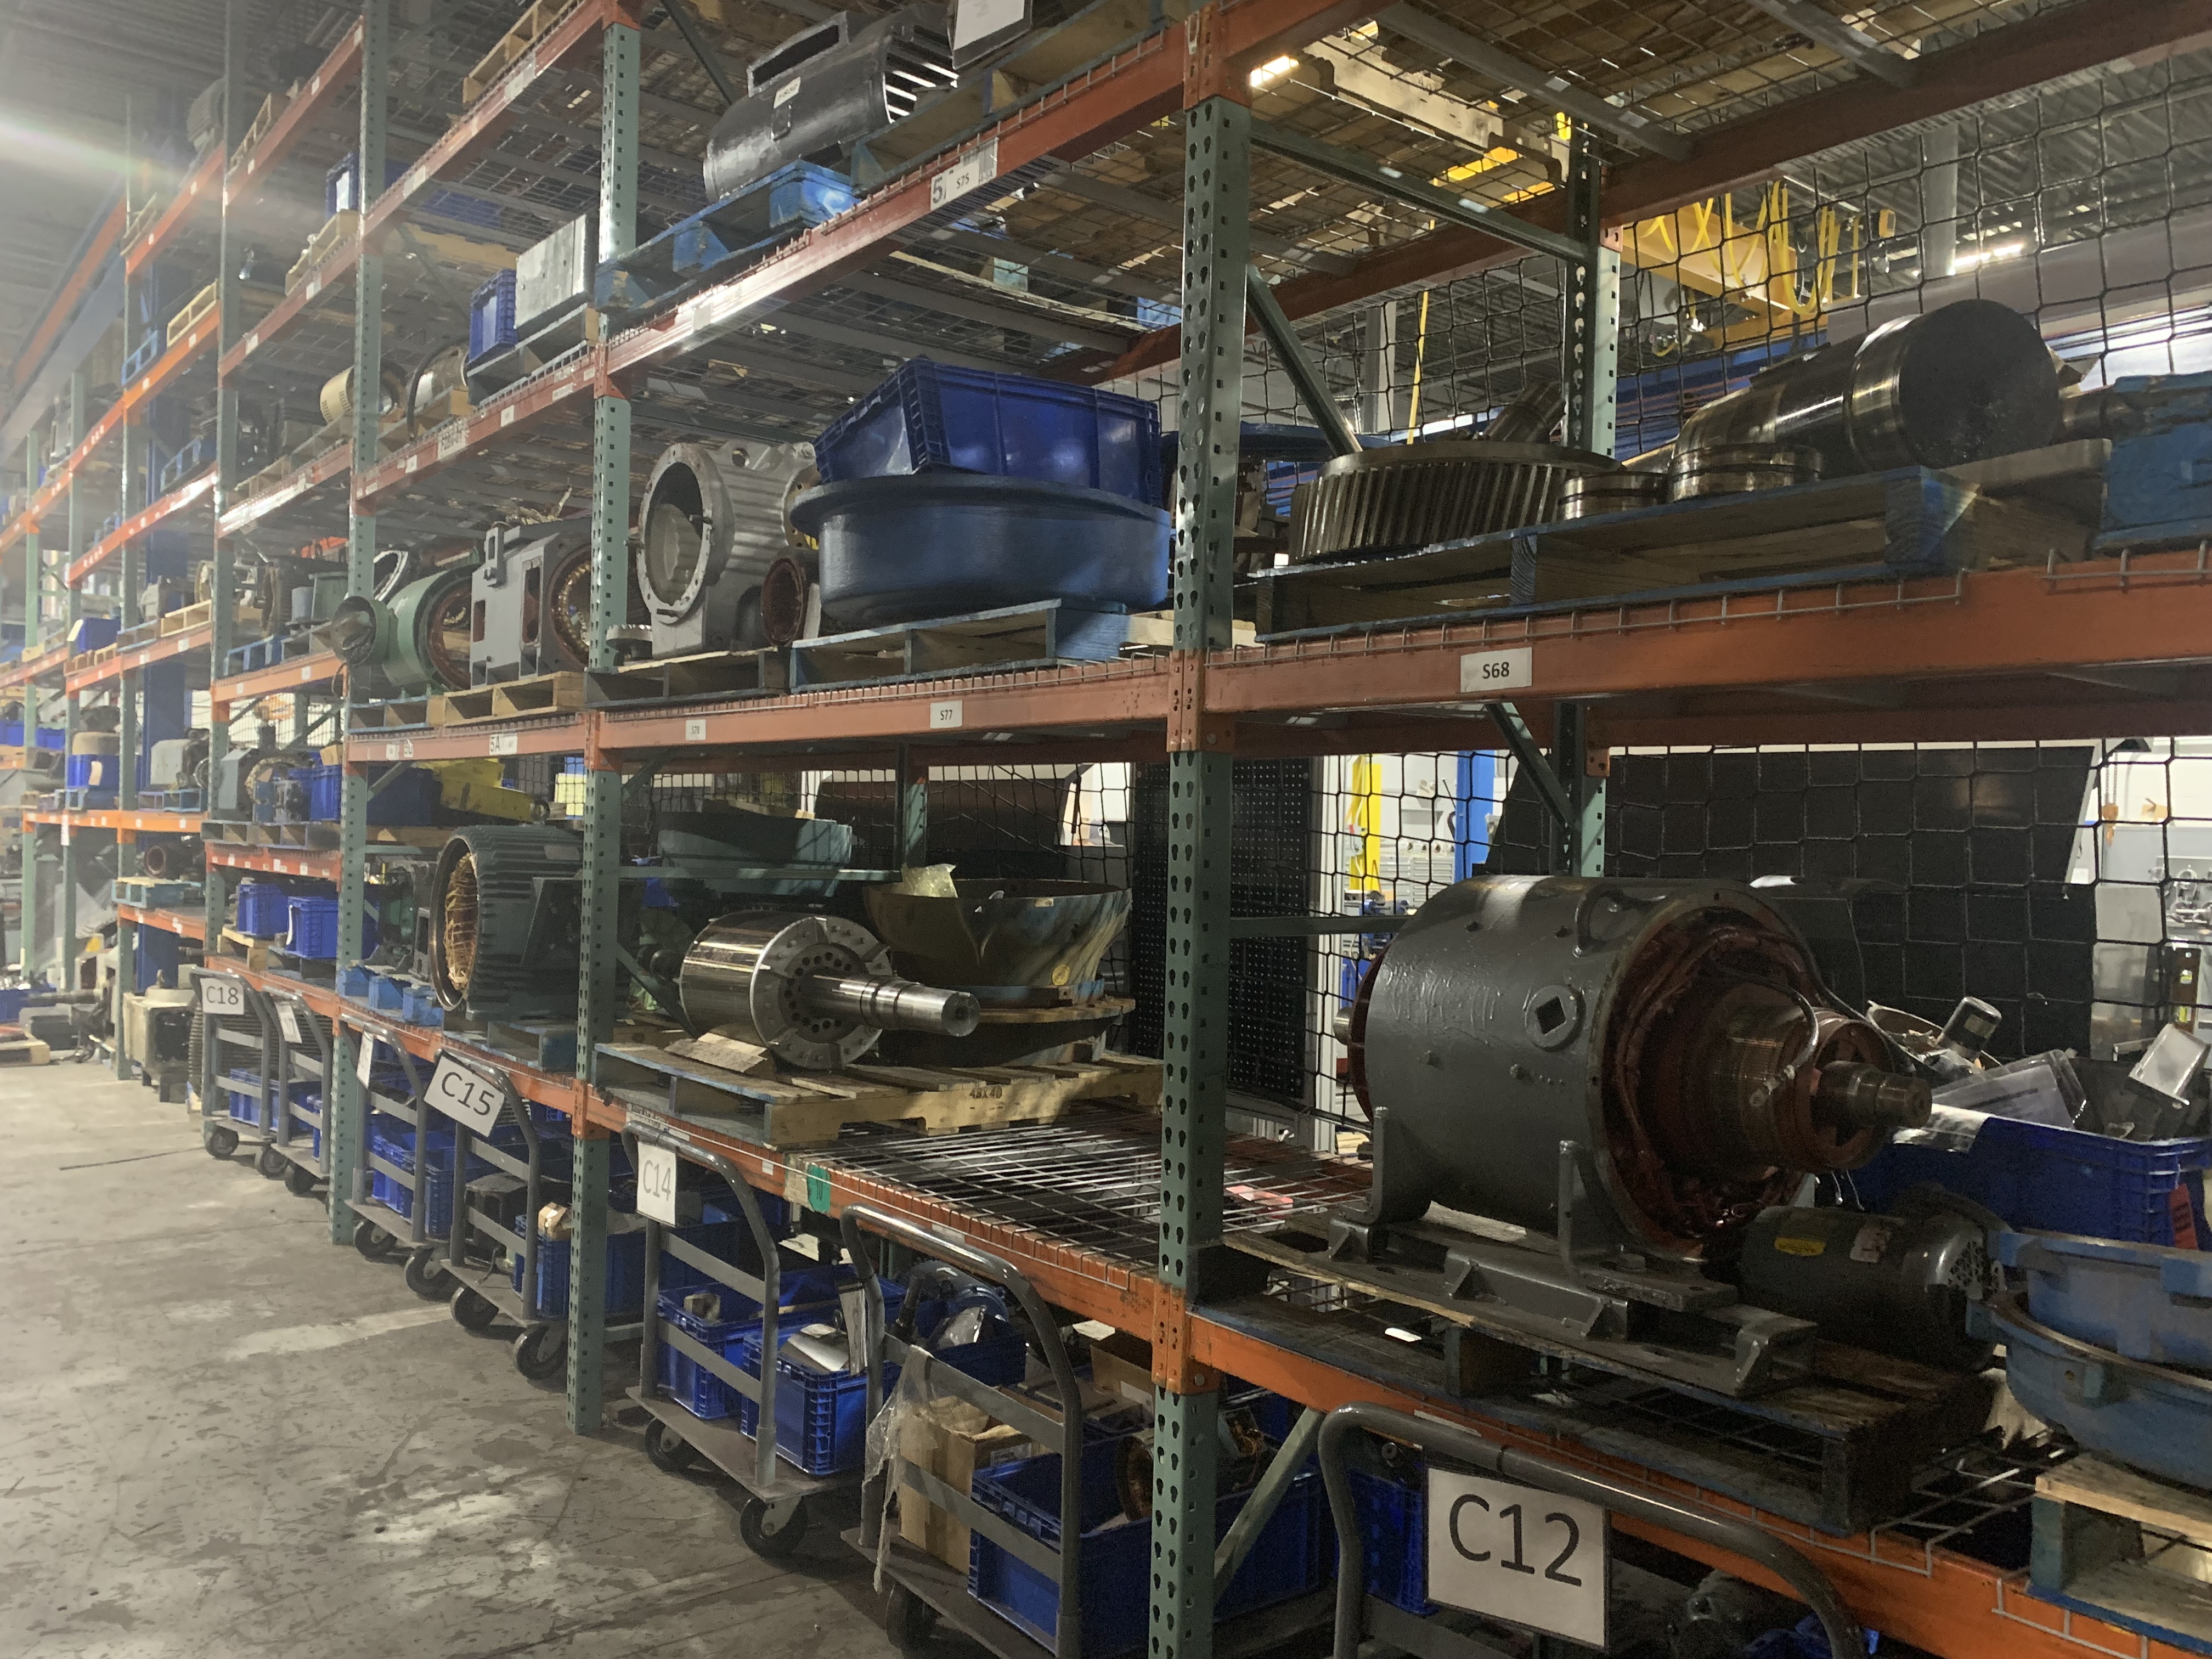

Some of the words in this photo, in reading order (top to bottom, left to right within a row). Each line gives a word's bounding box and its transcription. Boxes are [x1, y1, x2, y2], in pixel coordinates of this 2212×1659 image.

[956, 173, 969, 189] S75
[1482, 662, 1510, 679] S68
[940, 709, 953, 720] S77
[206, 985, 239, 1005] C18
[442, 1071, 495, 1116] C15
[643, 1159, 671, 1201] C14
[1449, 1494, 1582, 1588] C12
